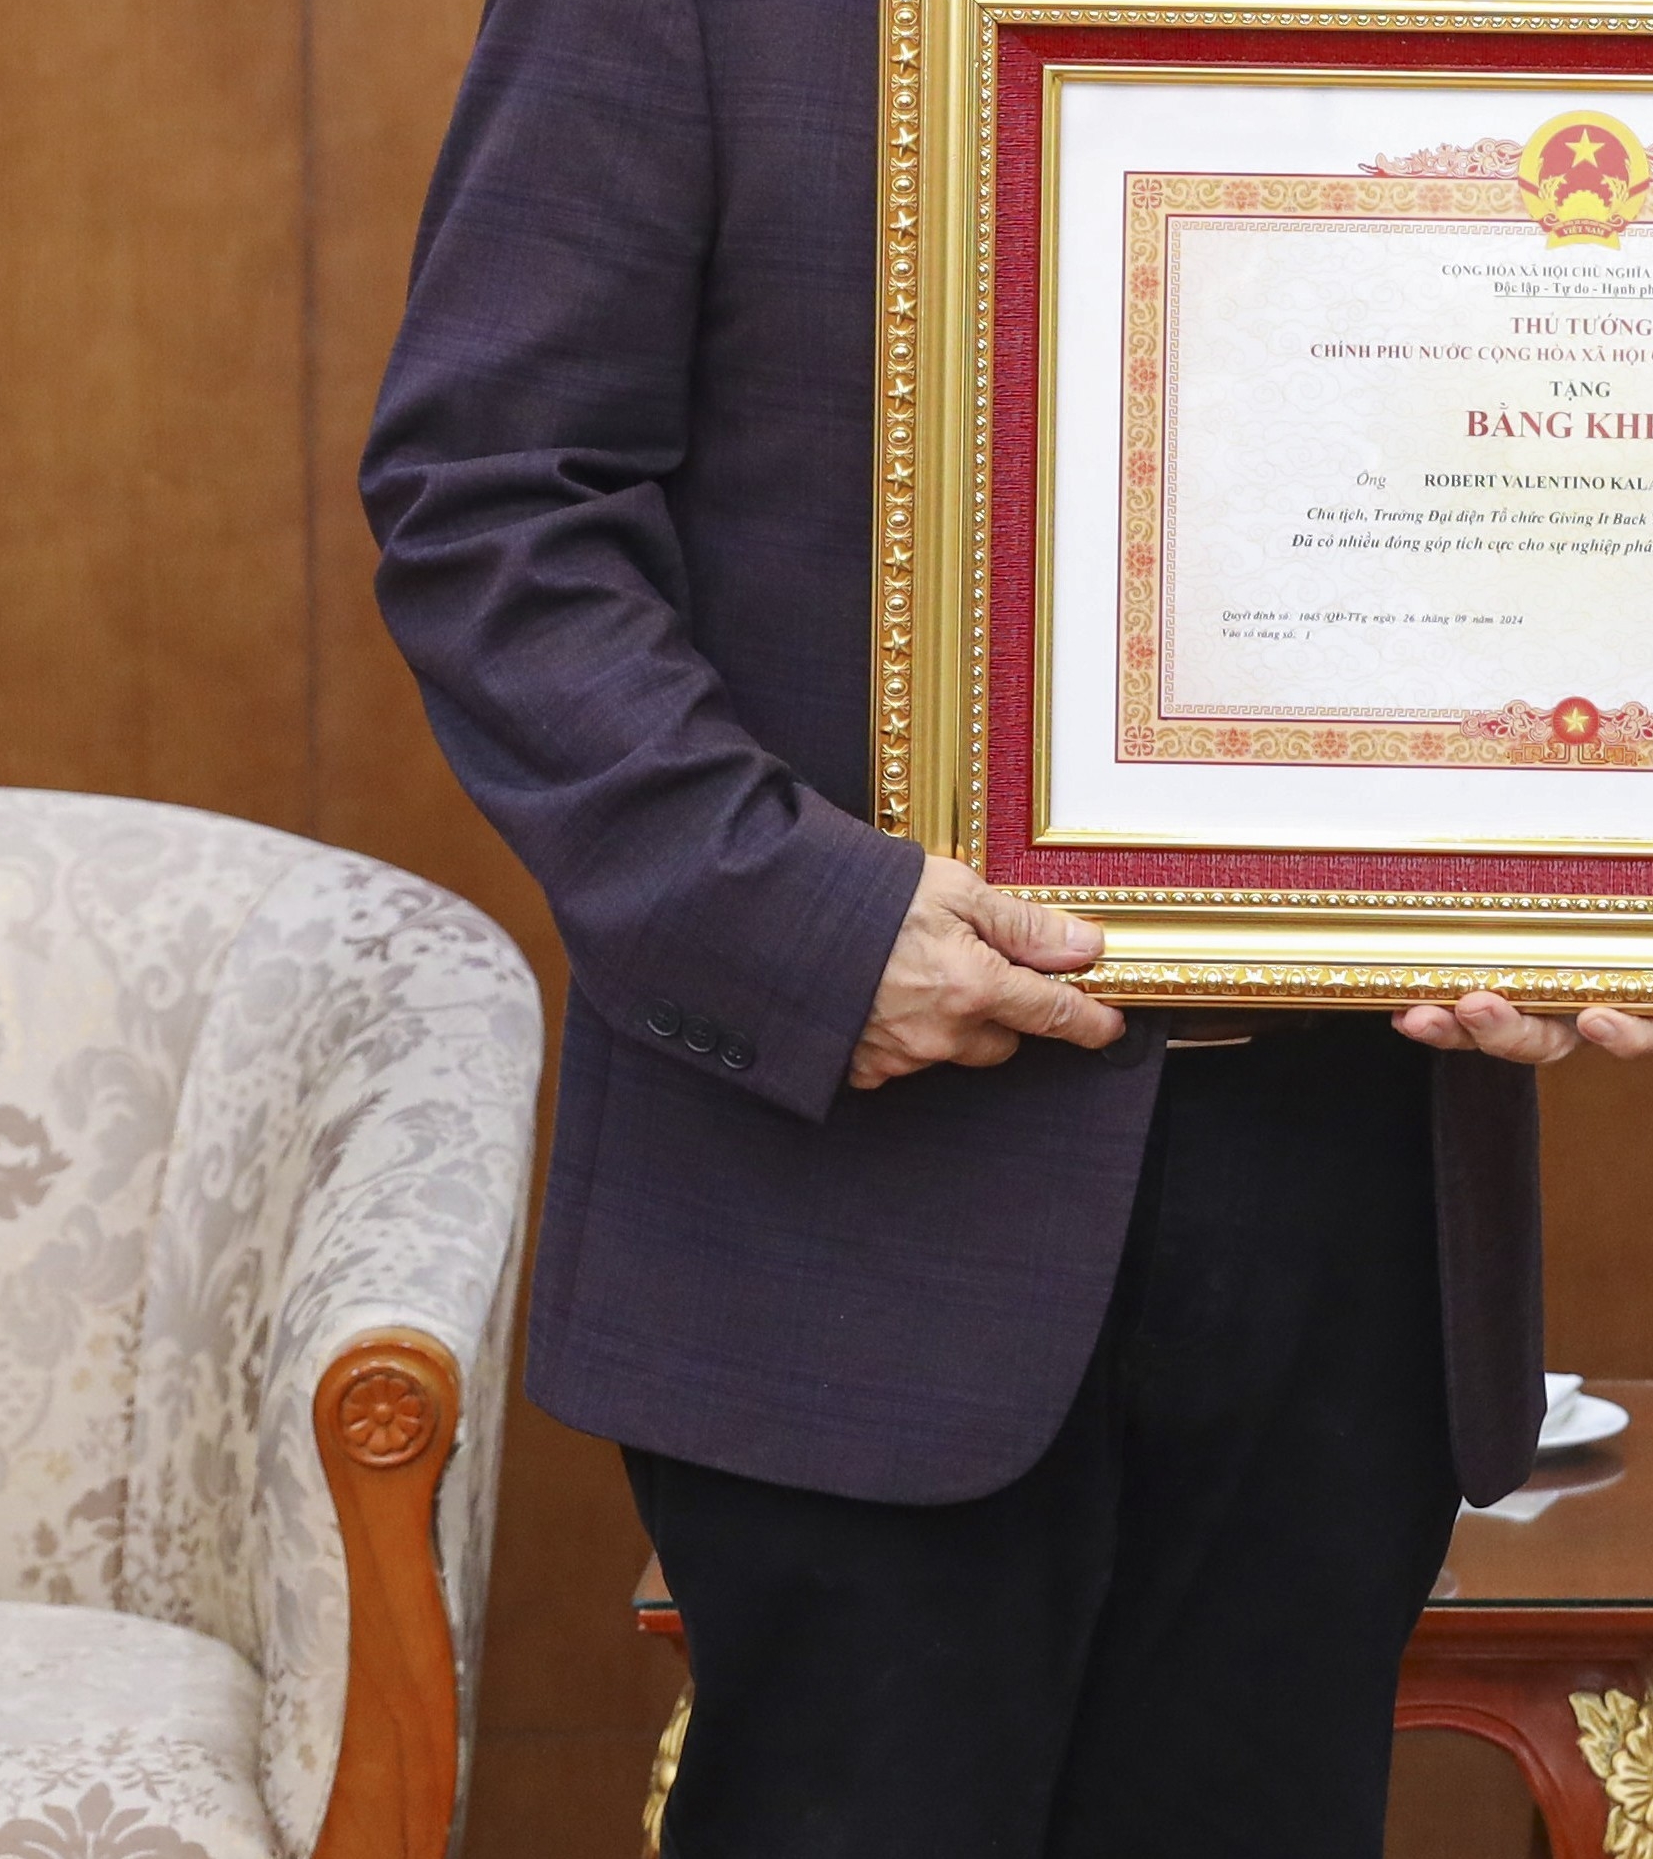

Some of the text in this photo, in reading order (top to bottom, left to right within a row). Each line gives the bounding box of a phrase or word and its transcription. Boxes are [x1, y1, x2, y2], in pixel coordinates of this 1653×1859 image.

[1494, 281, 1518, 296] Độc
[1553, 283, 1571, 297] Tự
[1575, 283, 1589, 294] do
[1602, 284, 1636, 297] Hạnh
[1566, 313, 1653, 336] TƯỚNG
[1310, 340, 1371, 358] CHÍNH
[1478, 344, 1531, 363] CỘNG
[1537, 344, 1576, 361] HÒA
[1582, 346, 1606, 362] XÃ
[1612, 348, 1645, 365] HỘI
[1549, 378, 1611, 401] TẶNG
[1466, 402, 1573, 440] BẰNG
[1356, 469, 1387, 491] Ông
[1424, 473, 1498, 488] ROBERT
[1502, 474, 1606, 490] VALENTINO
[1428, 510, 1452, 525] Đại
[1456, 510, 1485, 525] diện
[1511, 510, 1545, 525] chức
[1549, 511, 1594, 527] Giving
[1598, 512, 1608, 525] It
[1613, 512, 1646, 526] Back
[1292, 534, 1313, 548] Đã
[1317, 534, 1334, 548] có
[1338, 531, 1380, 549] nhiều
[1385, 534, 1421, 552] đóng
[1424, 536, 1452, 553] góp
[1456, 537, 1483, 551] tích
[1488, 538, 1514, 553] cực
[1518, 538, 1544, 551] cho
[1549, 540, 1566, 555] sự
[1571, 539, 1621, 556] nghiệp
[1403, 615, 1416, 623] 26
[1455, 615, 1467, 623] 09
[1500, 615, 1524, 625] 2024
